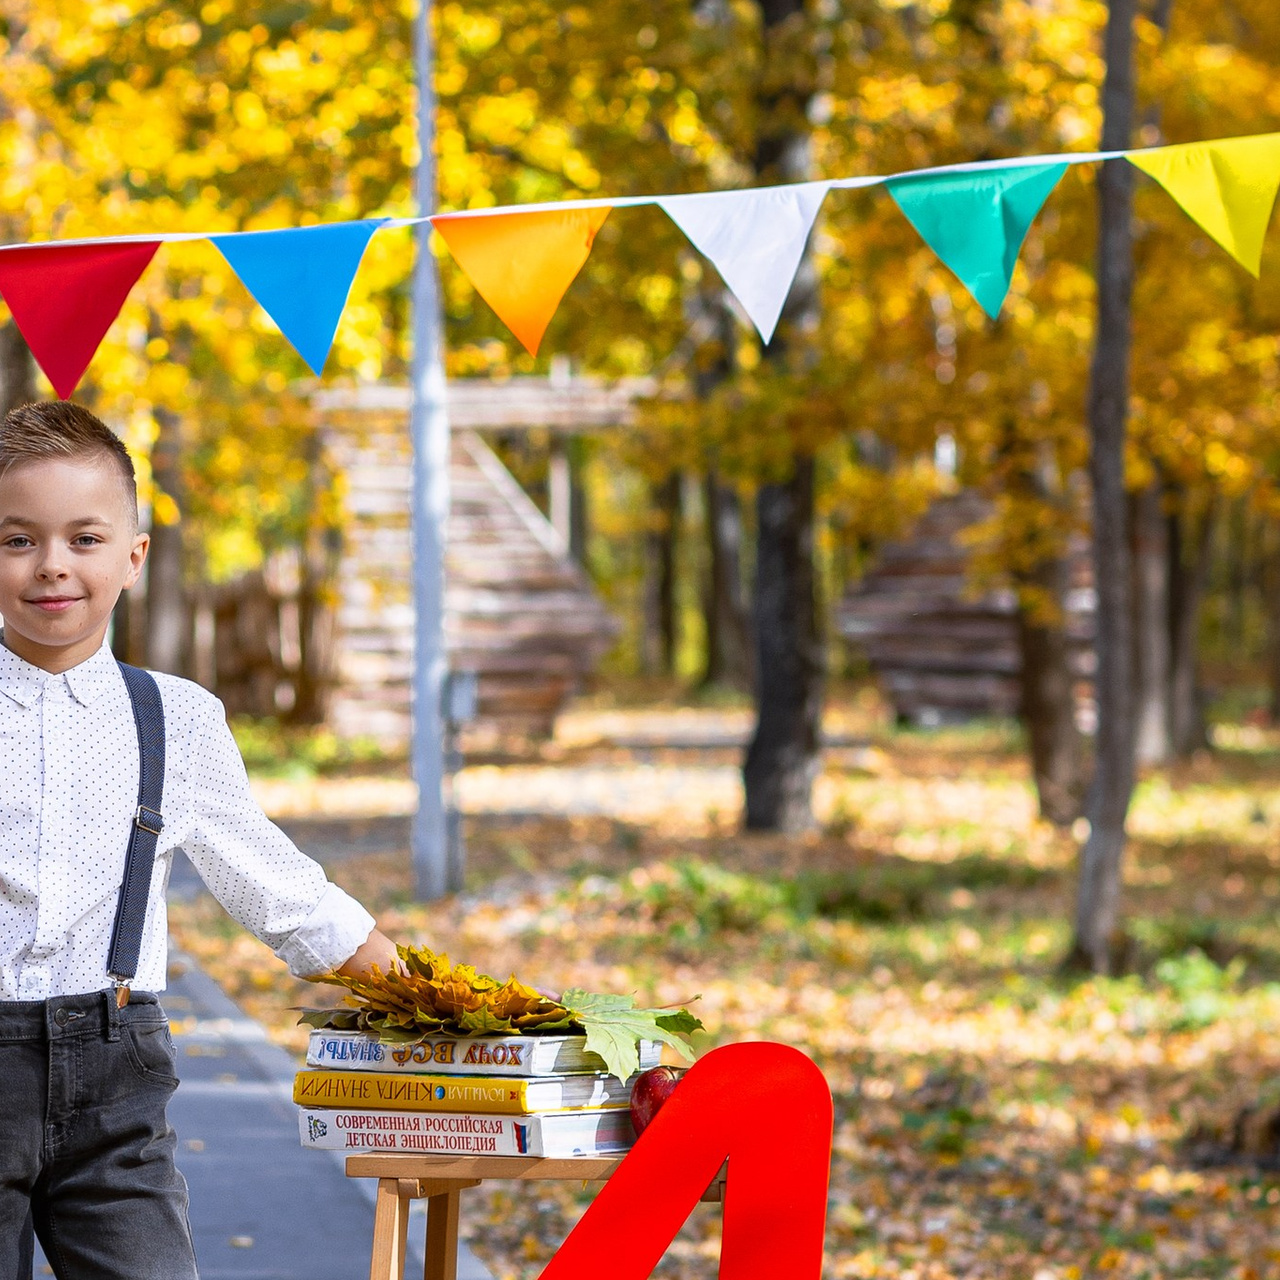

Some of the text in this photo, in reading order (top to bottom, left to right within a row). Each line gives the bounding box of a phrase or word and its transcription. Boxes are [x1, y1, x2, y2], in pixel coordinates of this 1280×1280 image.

[462, 1043, 523, 1066] ХОЧУ
[301, 1076, 505, 1102] БОЛЬШАЯ КНИГА ЗНАНИЙ
[335, 1114, 504, 1135] СОВРЕМЕННАЯ РОССИЙСКАЯ
[345, 1132, 497, 1152] ДЕТСКАЯ ЭНЦИКЛОПЕДИЯ
